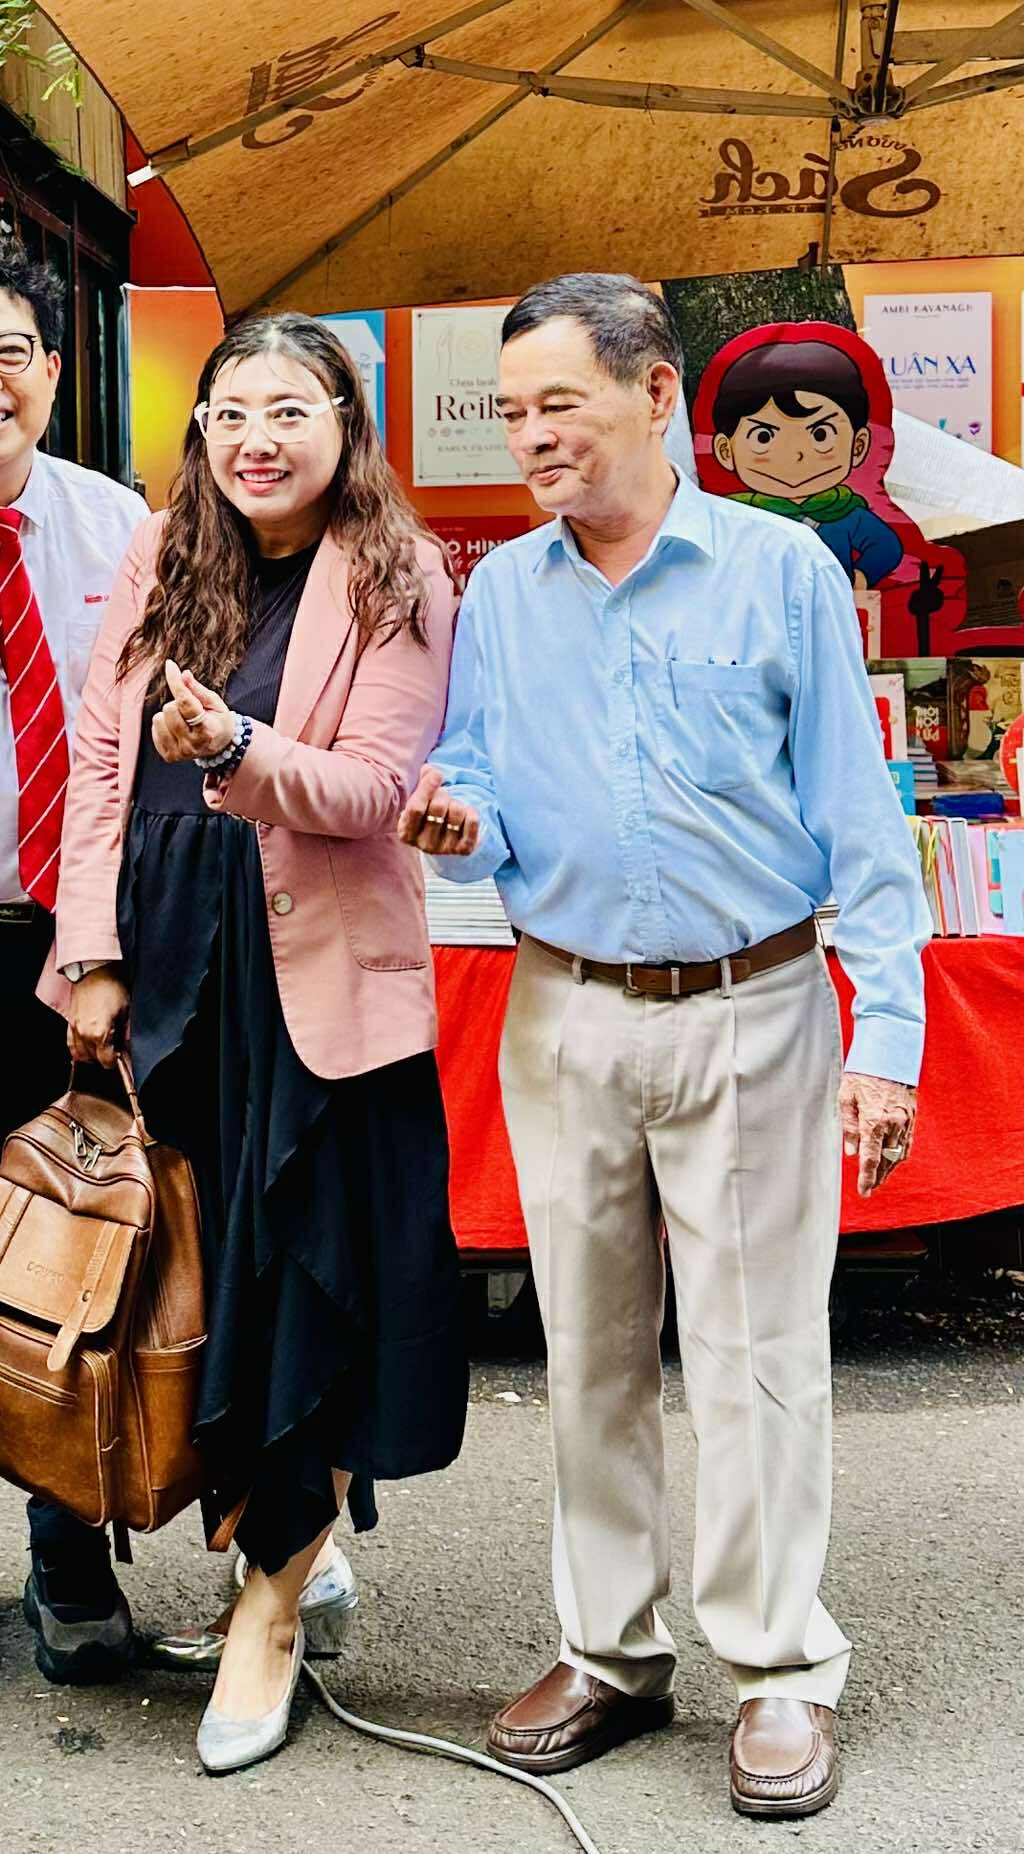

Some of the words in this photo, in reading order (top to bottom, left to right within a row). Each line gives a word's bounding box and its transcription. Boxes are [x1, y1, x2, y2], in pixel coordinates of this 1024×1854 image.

[946, 354, 977, 376] XA
[435, 394, 504, 421] Reik
[466, 537, 508, 555] HÌN
